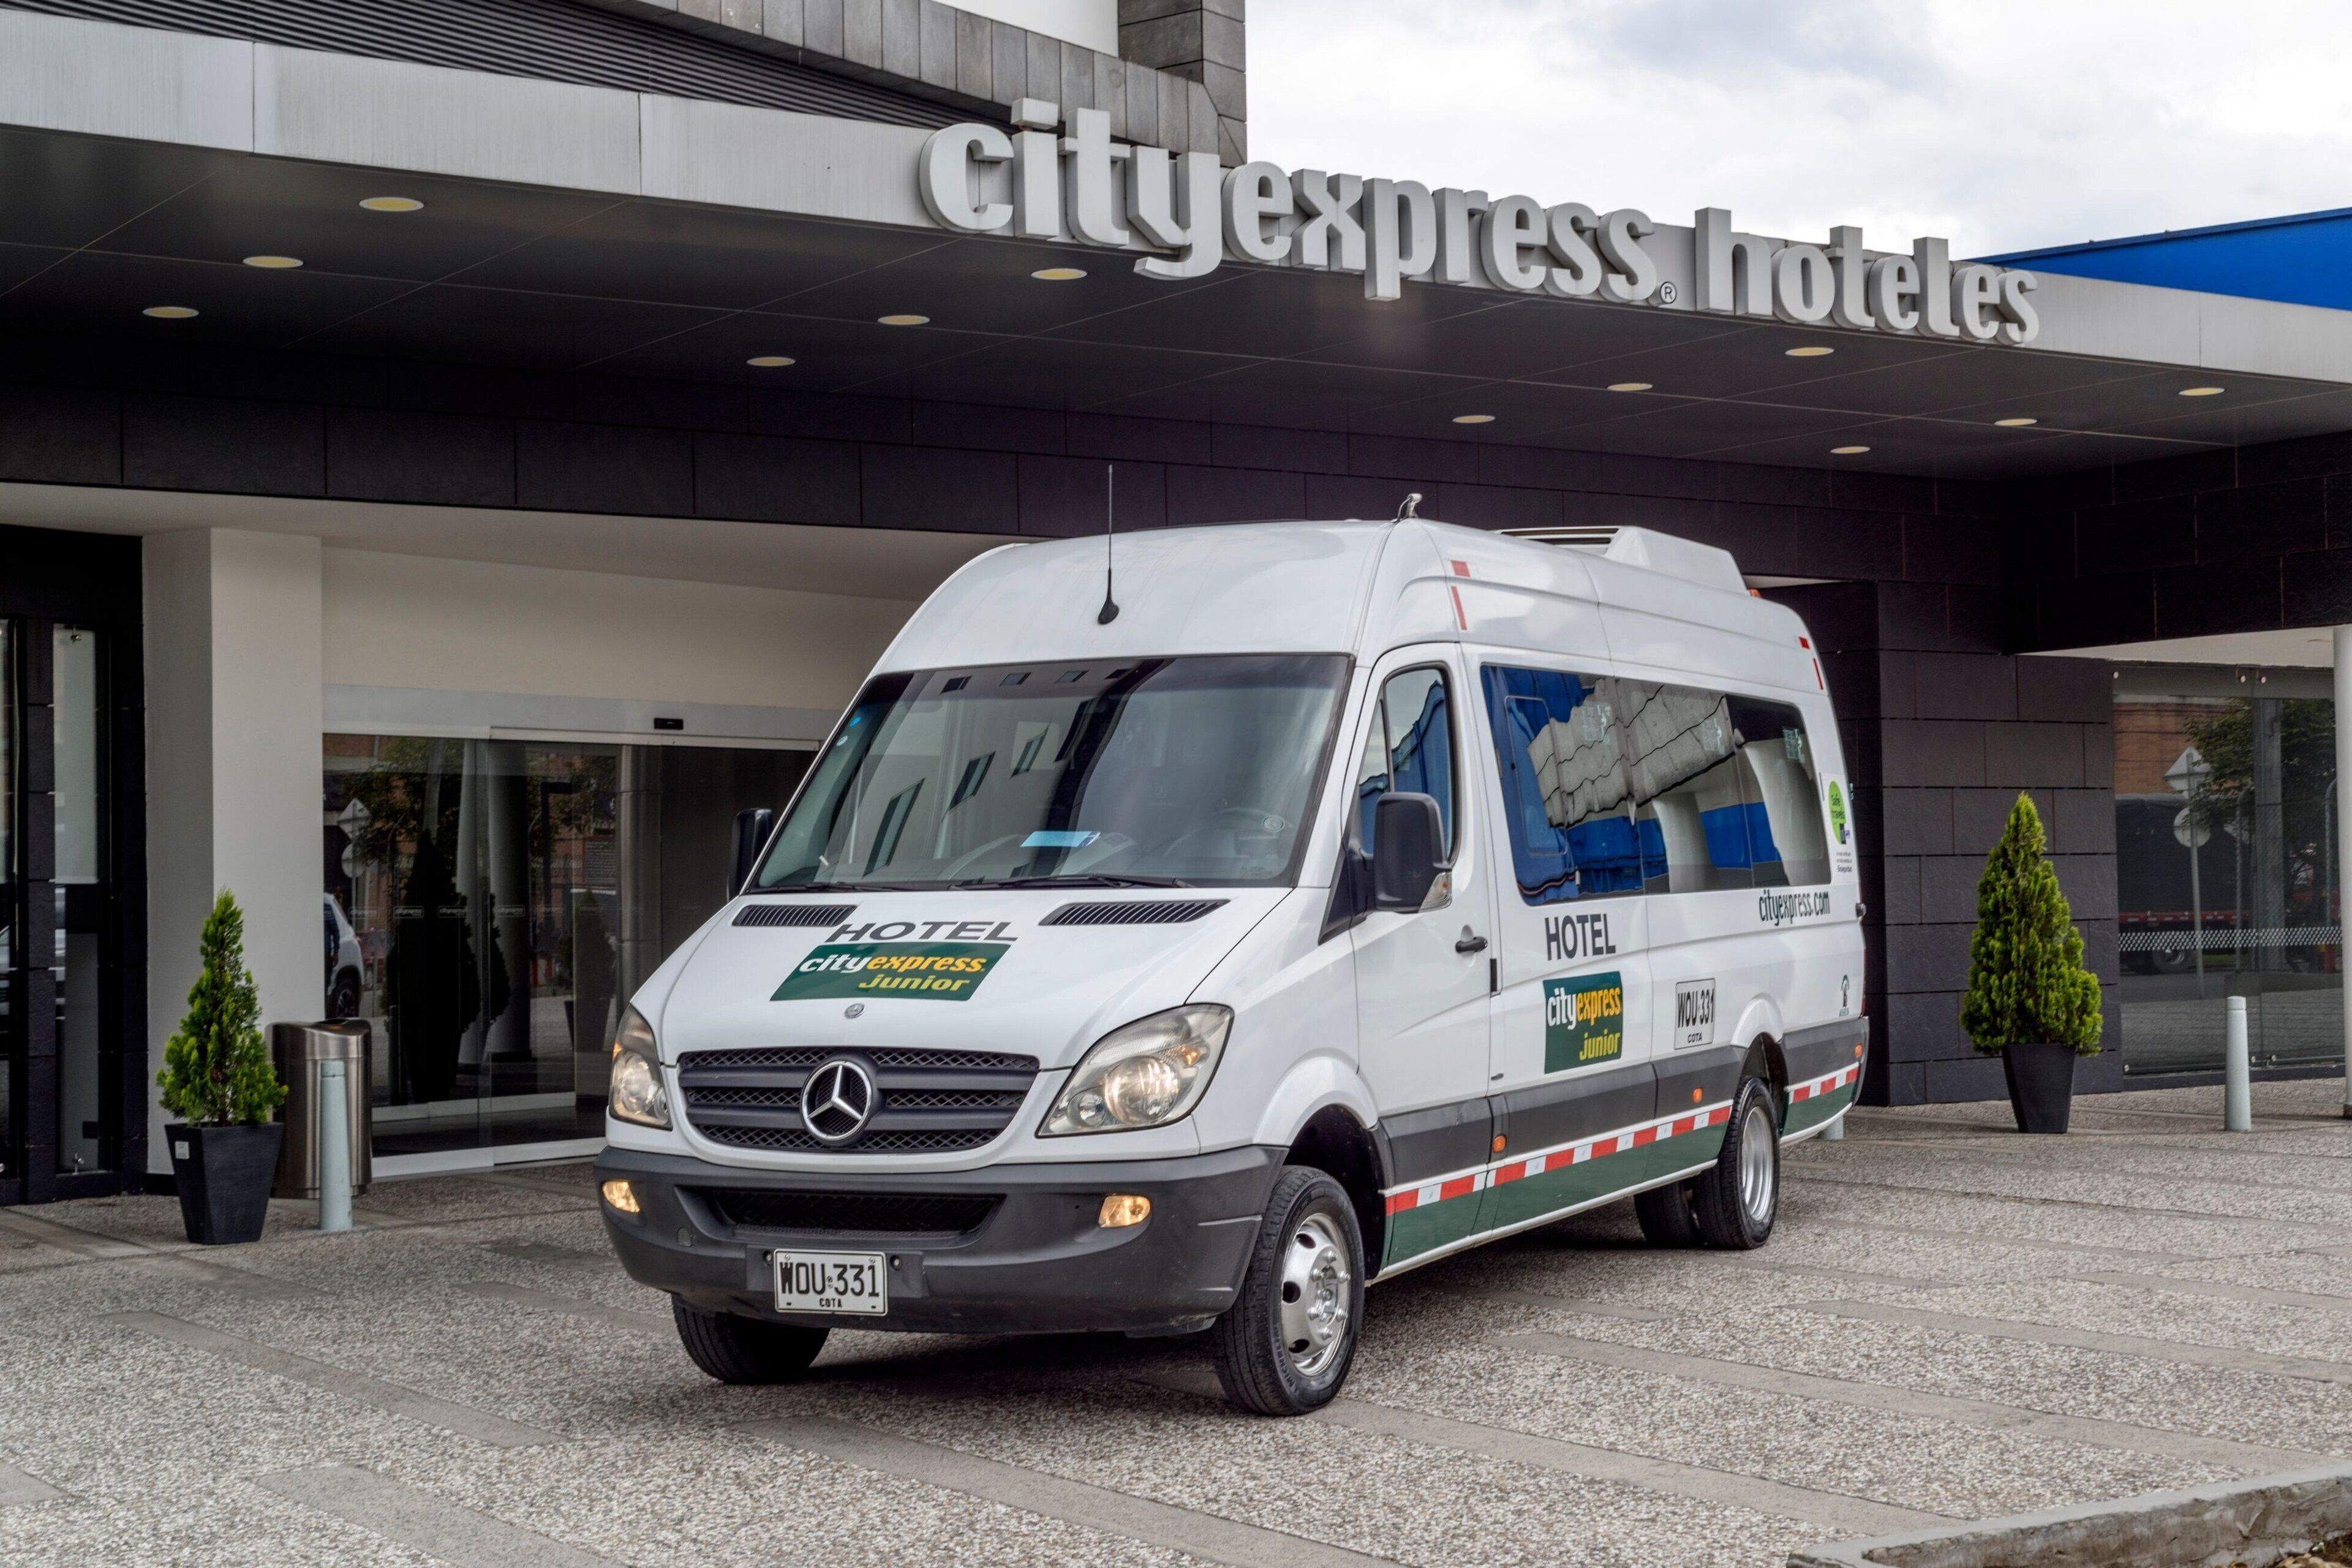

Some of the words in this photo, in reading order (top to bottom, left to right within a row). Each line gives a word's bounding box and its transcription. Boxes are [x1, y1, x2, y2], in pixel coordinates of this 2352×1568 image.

[1695, 206, 2038, 344] hoteles
[1759, 889, 1830, 926] cityexpress.com
[824, 921, 1018, 943] HOTEL
[1545, 913, 1616, 960] HOTEL
[799, 954, 987, 973] cityexpress
[858, 974, 971, 991] junior
[1547, 987, 1621, 1030] cityexpress
[1579, 1029, 1621, 1060] junior
[1687, 1032, 1702, 1044] COTA
[819, 1298, 843, 1308] COTA
